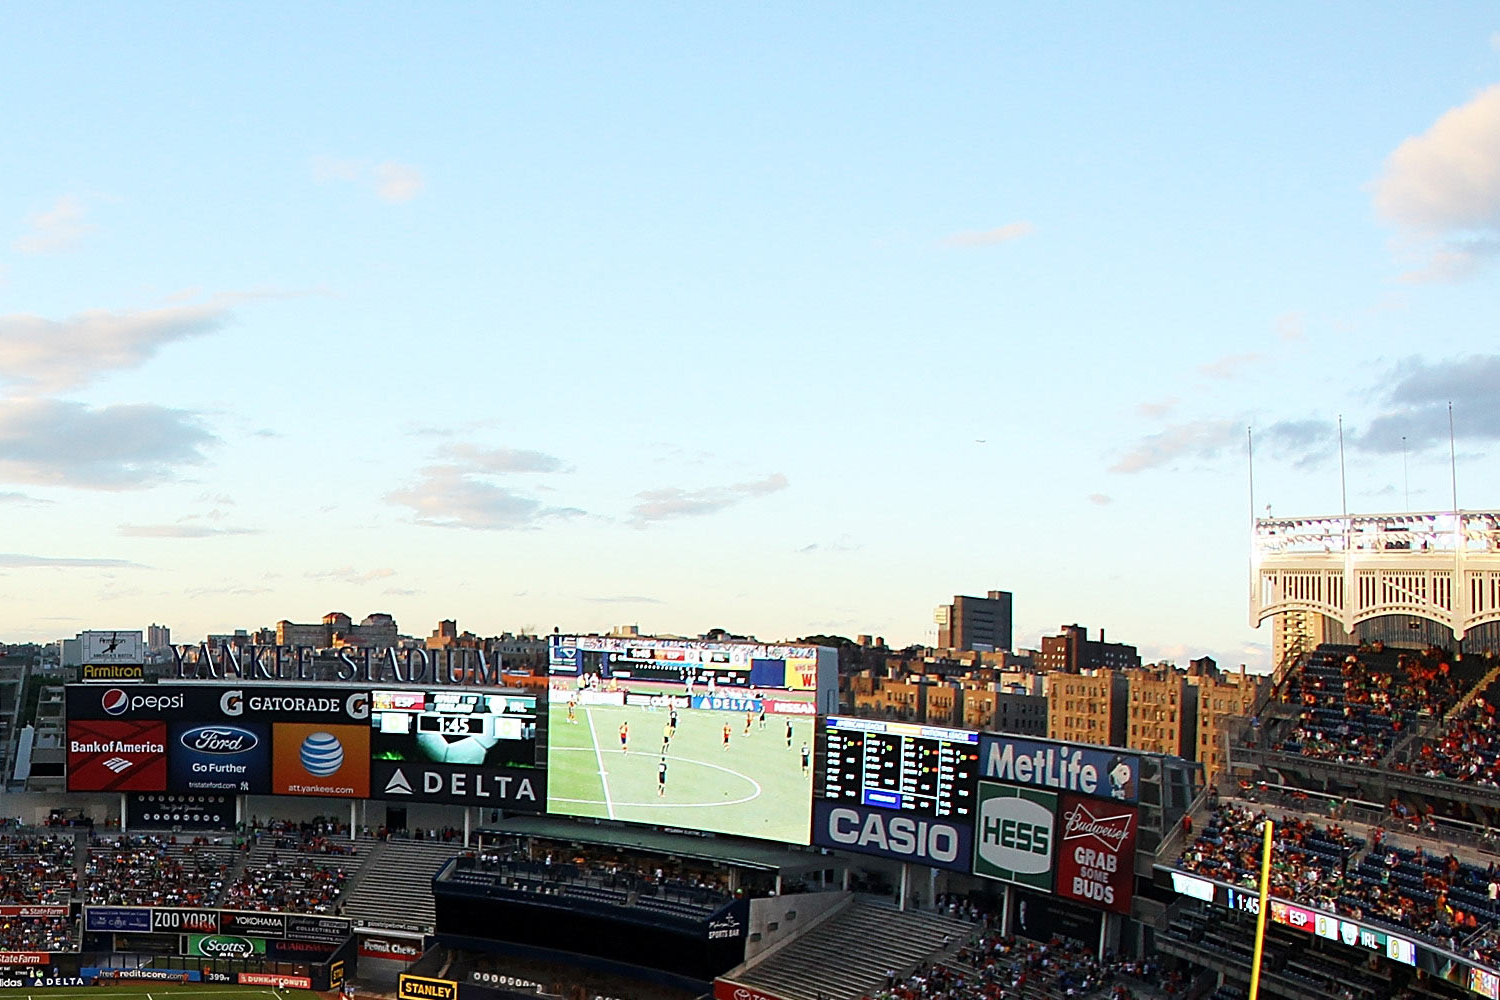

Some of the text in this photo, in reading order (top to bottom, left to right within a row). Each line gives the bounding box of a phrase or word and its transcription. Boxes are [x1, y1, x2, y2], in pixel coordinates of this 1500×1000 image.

[84, 665, 142, 678] Armitron
[169, 642, 506, 686] YANKEE STADIUM
[131, 693, 184, 712] pepsi
[249, 697, 340, 712] GATORADE
[712, 698, 754, 711] DELTA
[774, 702, 816, 714] NISSAN
[436, 718, 469, 733] 1:45
[71, 741, 164, 753] Bank of America
[195, 730, 242, 751] Ford
[192, 763, 247, 774] Go Further
[986, 742, 1099, 794] MetLife
[288, 784, 354, 795] att.yankees.com
[424, 771, 537, 801] DELTA
[1064, 811, 1130, 841] Budweiser
[828, 808, 959, 863] CASIO
[982, 815, 1049, 856] HESS
[1073, 846, 1118, 873] GRAB
[1080, 866, 1110, 884] SOME
[1072, 877, 1115, 904] BUDS
[154, 912, 180, 927] ZOO
[182, 913, 216, 930] YORK
[235, 916, 283, 928] YOKOHAMA
[1236, 895, 1261, 915] 1:45
[1289, 909, 1308, 927] ESP
[1361, 931, 1379, 949] IRL
[296, 926, 341, 935] COLLECTIBLES
[206, 939, 246, 954] Scotts
[363, 941, 390, 953] Peanut
[46, 977, 84, 987] DELTA
[405, 982, 452, 1000] STANLEY
